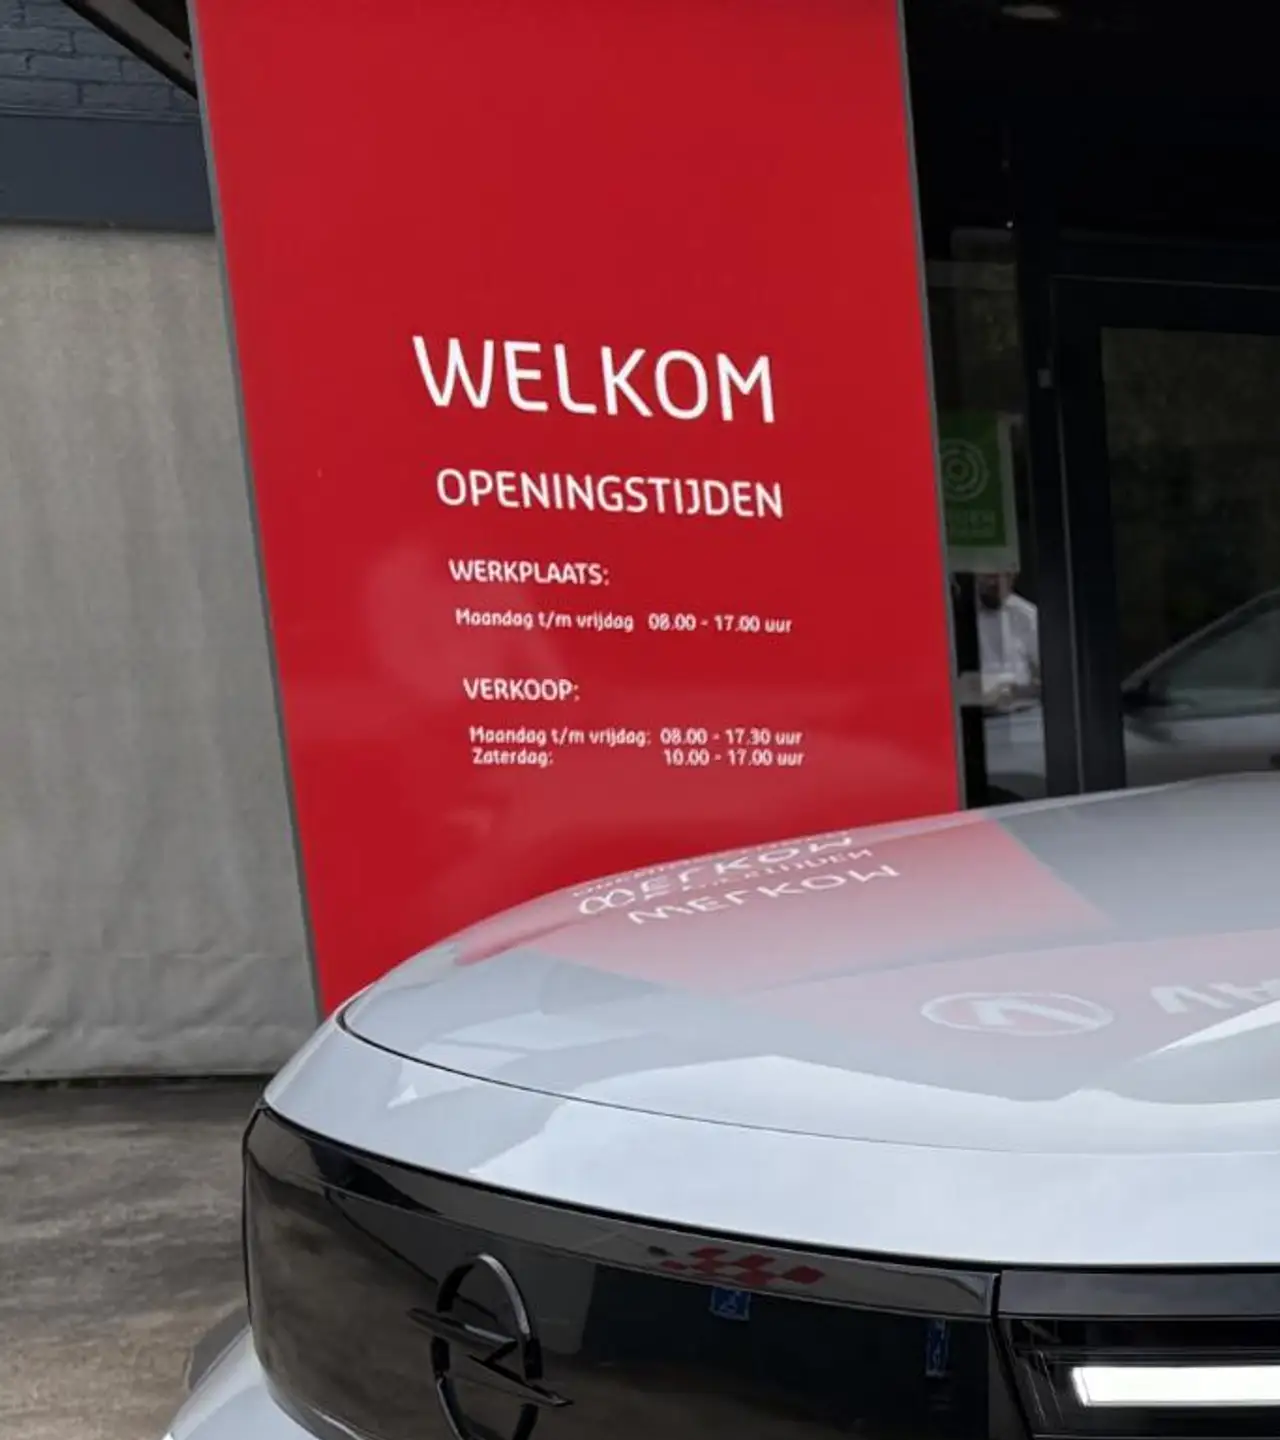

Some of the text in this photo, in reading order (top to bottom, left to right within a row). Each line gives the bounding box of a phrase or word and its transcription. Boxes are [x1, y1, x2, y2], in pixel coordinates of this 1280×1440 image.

[411, 334, 775, 424] WELKOM
[436, 467, 784, 519] OPENINGSTIJDEN
[448, 559, 609, 586] WERKPLAATS:
[454, 607, 535, 631] Maandag
[537, 610, 572, 631] t/m
[575, 610, 634, 634] vrijdag
[647, 612, 697, 632] 08.00
[714, 613, 761, 633] 17.00
[764, 618, 792, 634] uur
[462, 677, 580, 702] VERKOOP:
[469, 725, 548, 748] Maandag
[550, 726, 585, 747] t/m
[588, 727, 651, 748] vrijdag:
[659, 727, 709, 746] 08.00
[725, 727, 772, 746] 17.30
[774, 731, 803, 746] uur
[472, 747, 554, 769] Zaterdag:
[663, 747, 710, 767] 10.00
[727, 747, 774, 767] 17.00
[776, 752, 805, 767] uur
